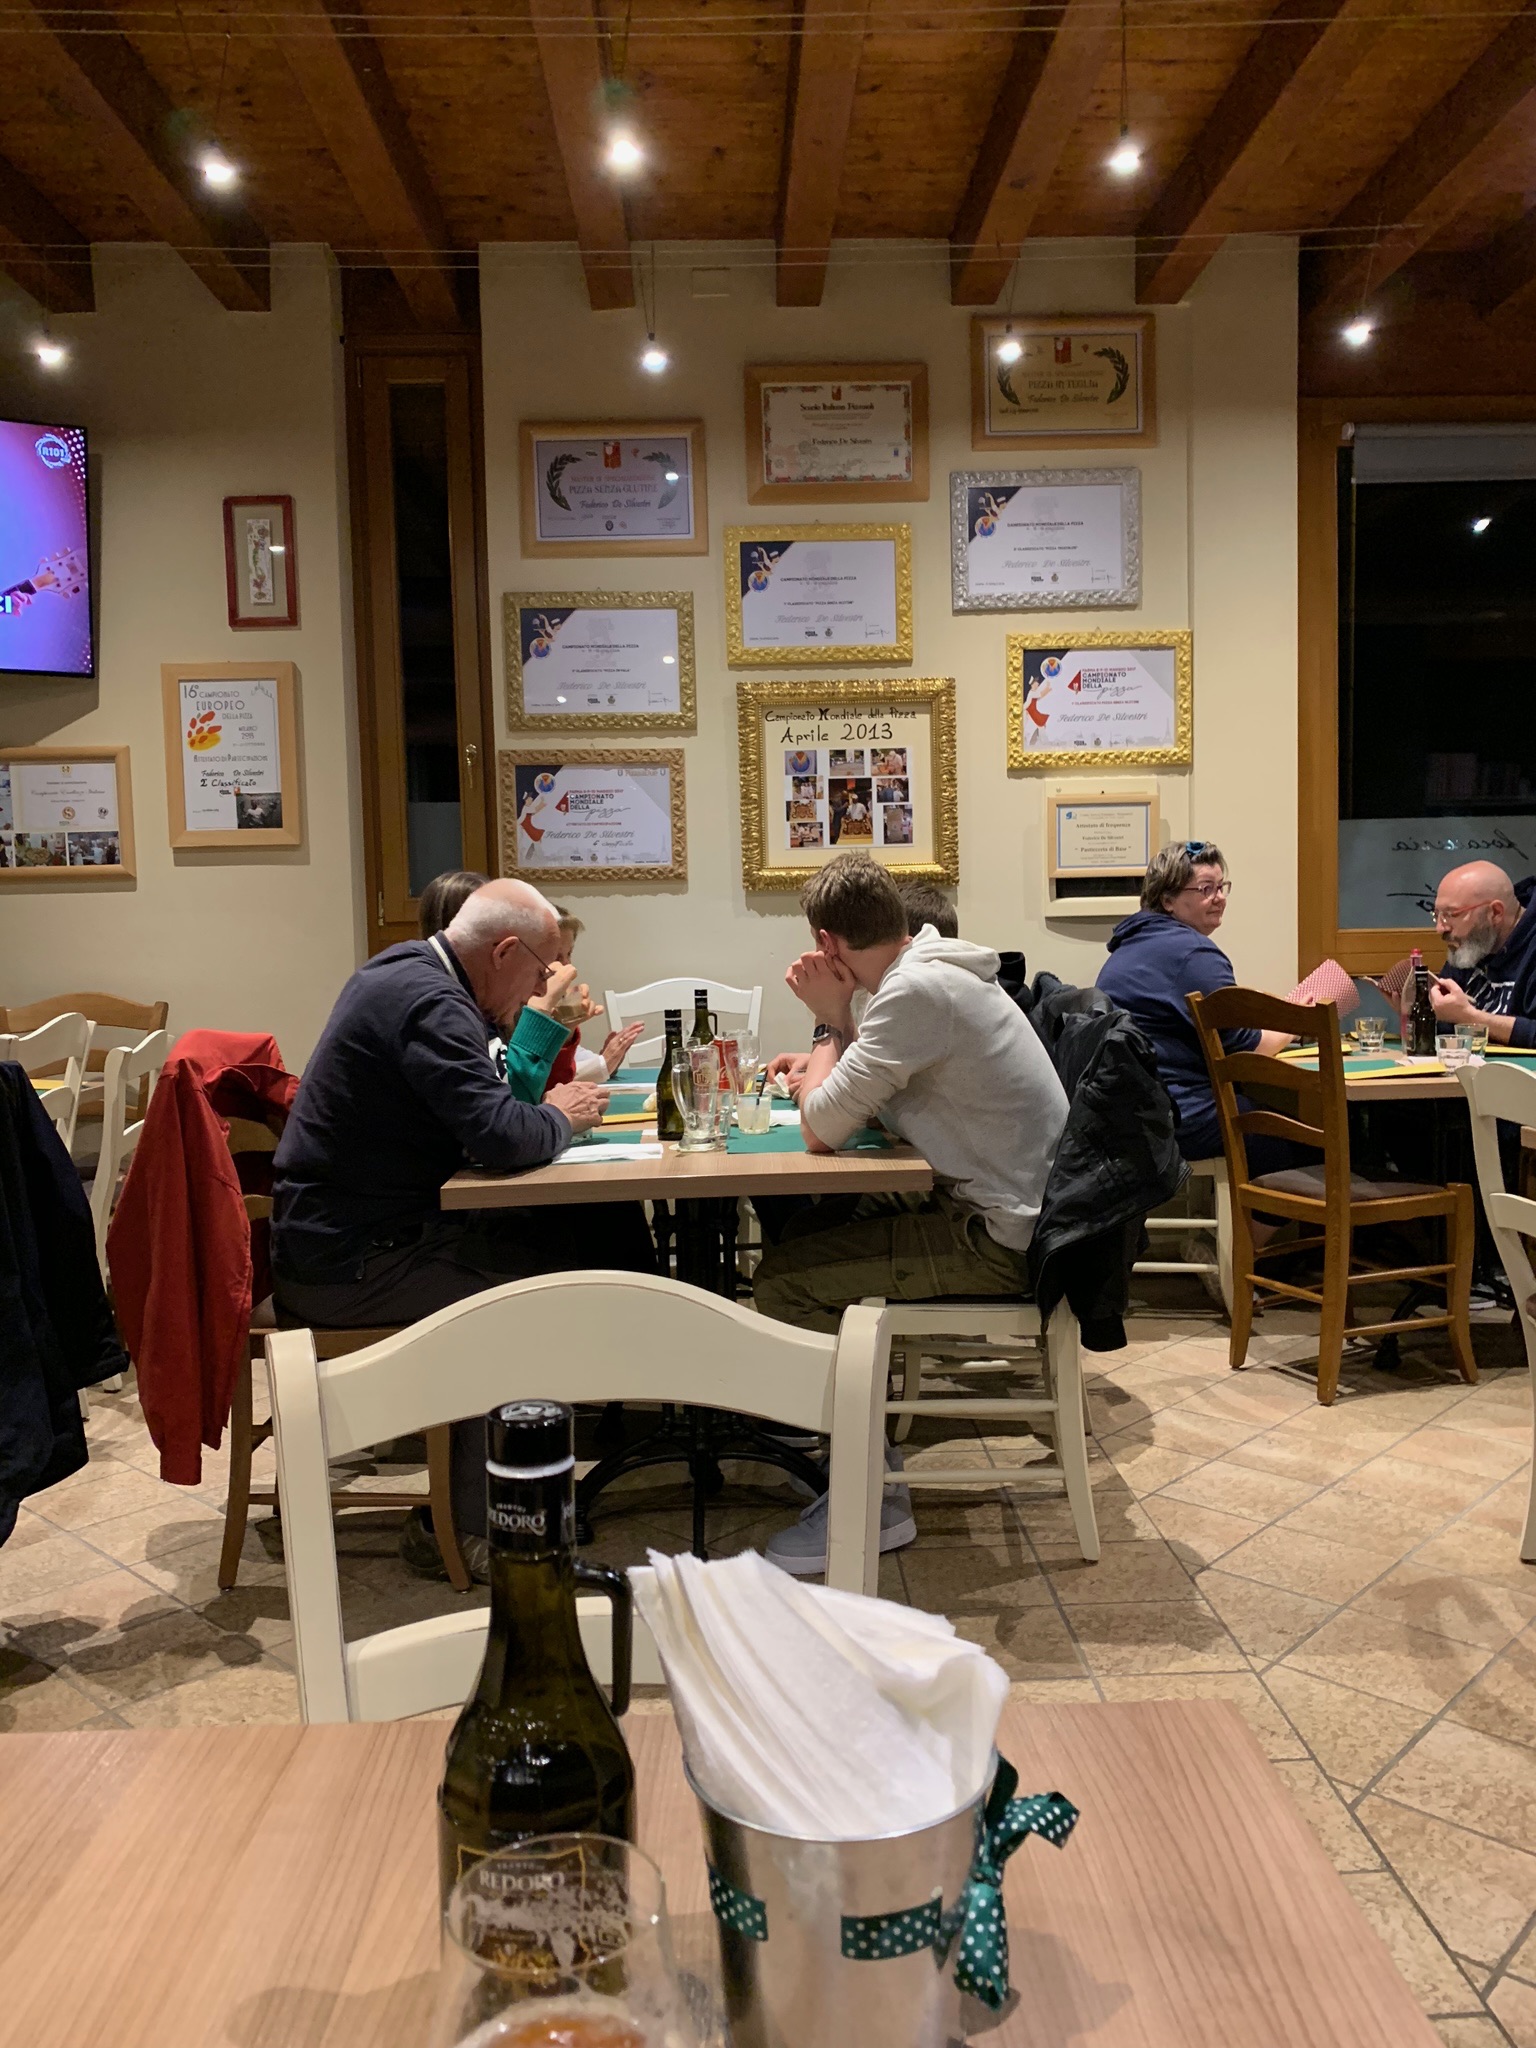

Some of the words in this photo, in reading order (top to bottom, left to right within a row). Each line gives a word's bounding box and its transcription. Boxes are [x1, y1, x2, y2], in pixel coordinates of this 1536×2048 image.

[199, 690, 240, 698] CAMPIONATO
[196, 700, 245, 711] EUROPEO
[765, 709, 816, 725] Campionato
[868, 707, 885, 719] della
[1057, 713, 1095, 723] Federico
[1097, 713, 1111, 722] De
[1113, 712, 1148, 721] Silvestri
[780, 725, 829, 745] Aprile
[840, 722, 893, 741] 2013
[544, 830, 581, 839] Federico
[583, 830, 597, 839] De
[599, 830, 635, 839] Silvestri
